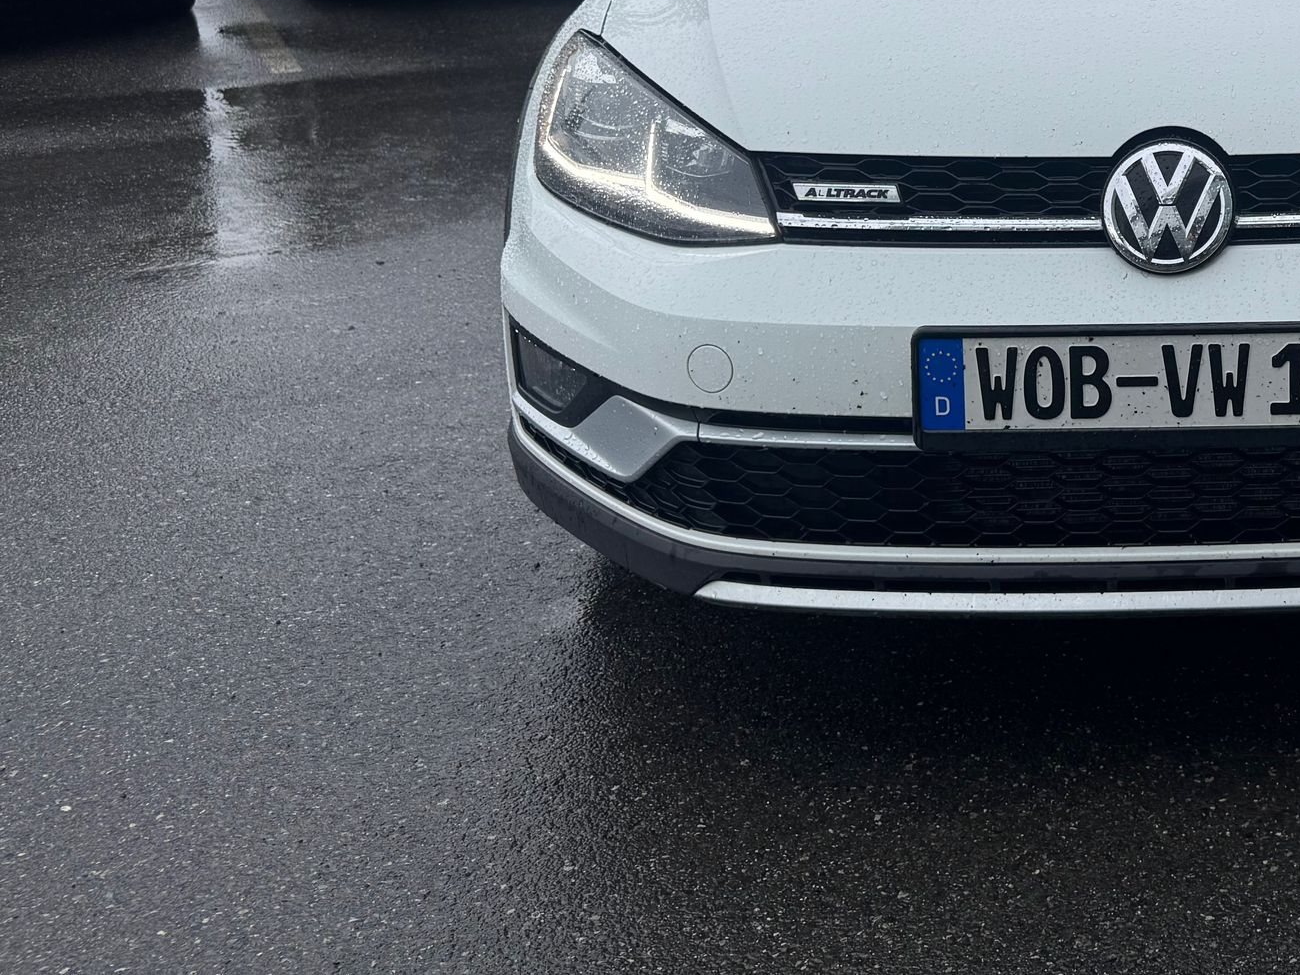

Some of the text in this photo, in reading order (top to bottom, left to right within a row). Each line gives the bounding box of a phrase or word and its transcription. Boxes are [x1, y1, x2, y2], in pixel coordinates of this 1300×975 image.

[804, 187, 890, 199] ALLTRACK
[1103, 140, 1234, 273] VW
[934, 396, 950, 416] D
